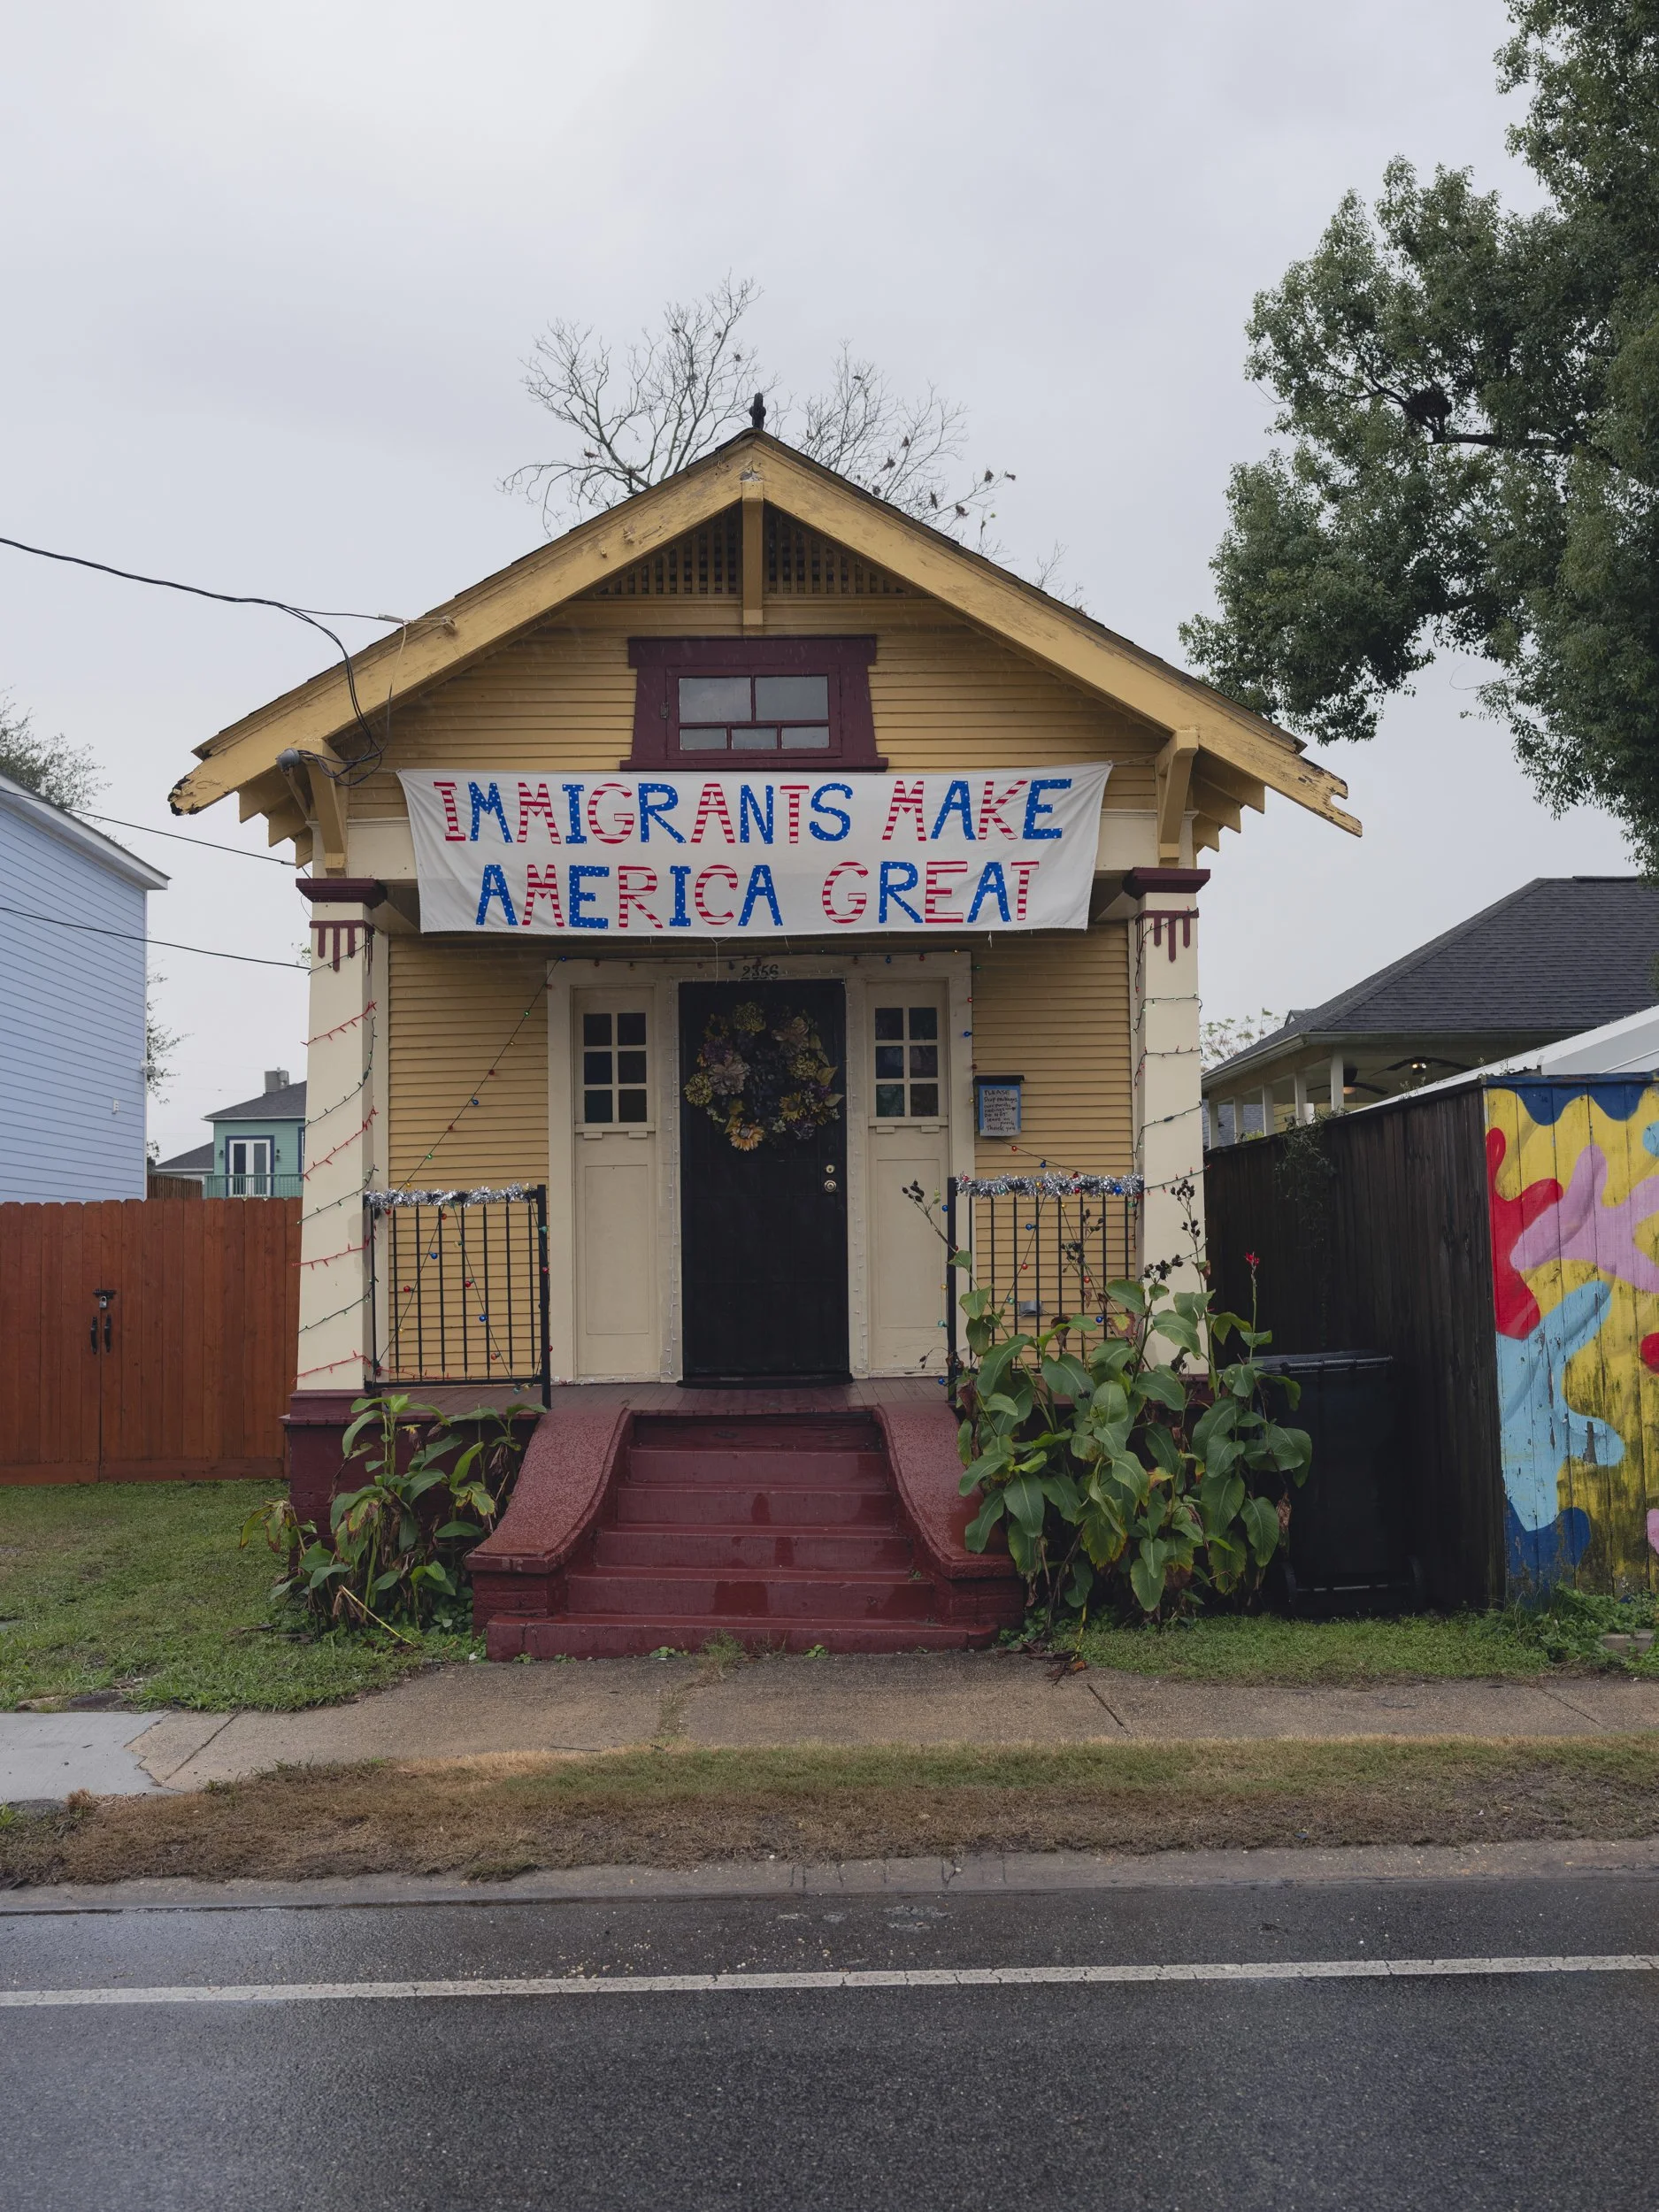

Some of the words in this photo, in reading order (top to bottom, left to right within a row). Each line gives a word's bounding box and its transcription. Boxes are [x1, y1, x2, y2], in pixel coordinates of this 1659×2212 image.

[434, 781, 853, 844] IMMIGRANTS
[882, 779, 1072, 841] MAKE
[475, 864, 783, 929] AMERICA
[822, 861, 1040, 924] GREAT
[741, 964, 779, 979] 2356
